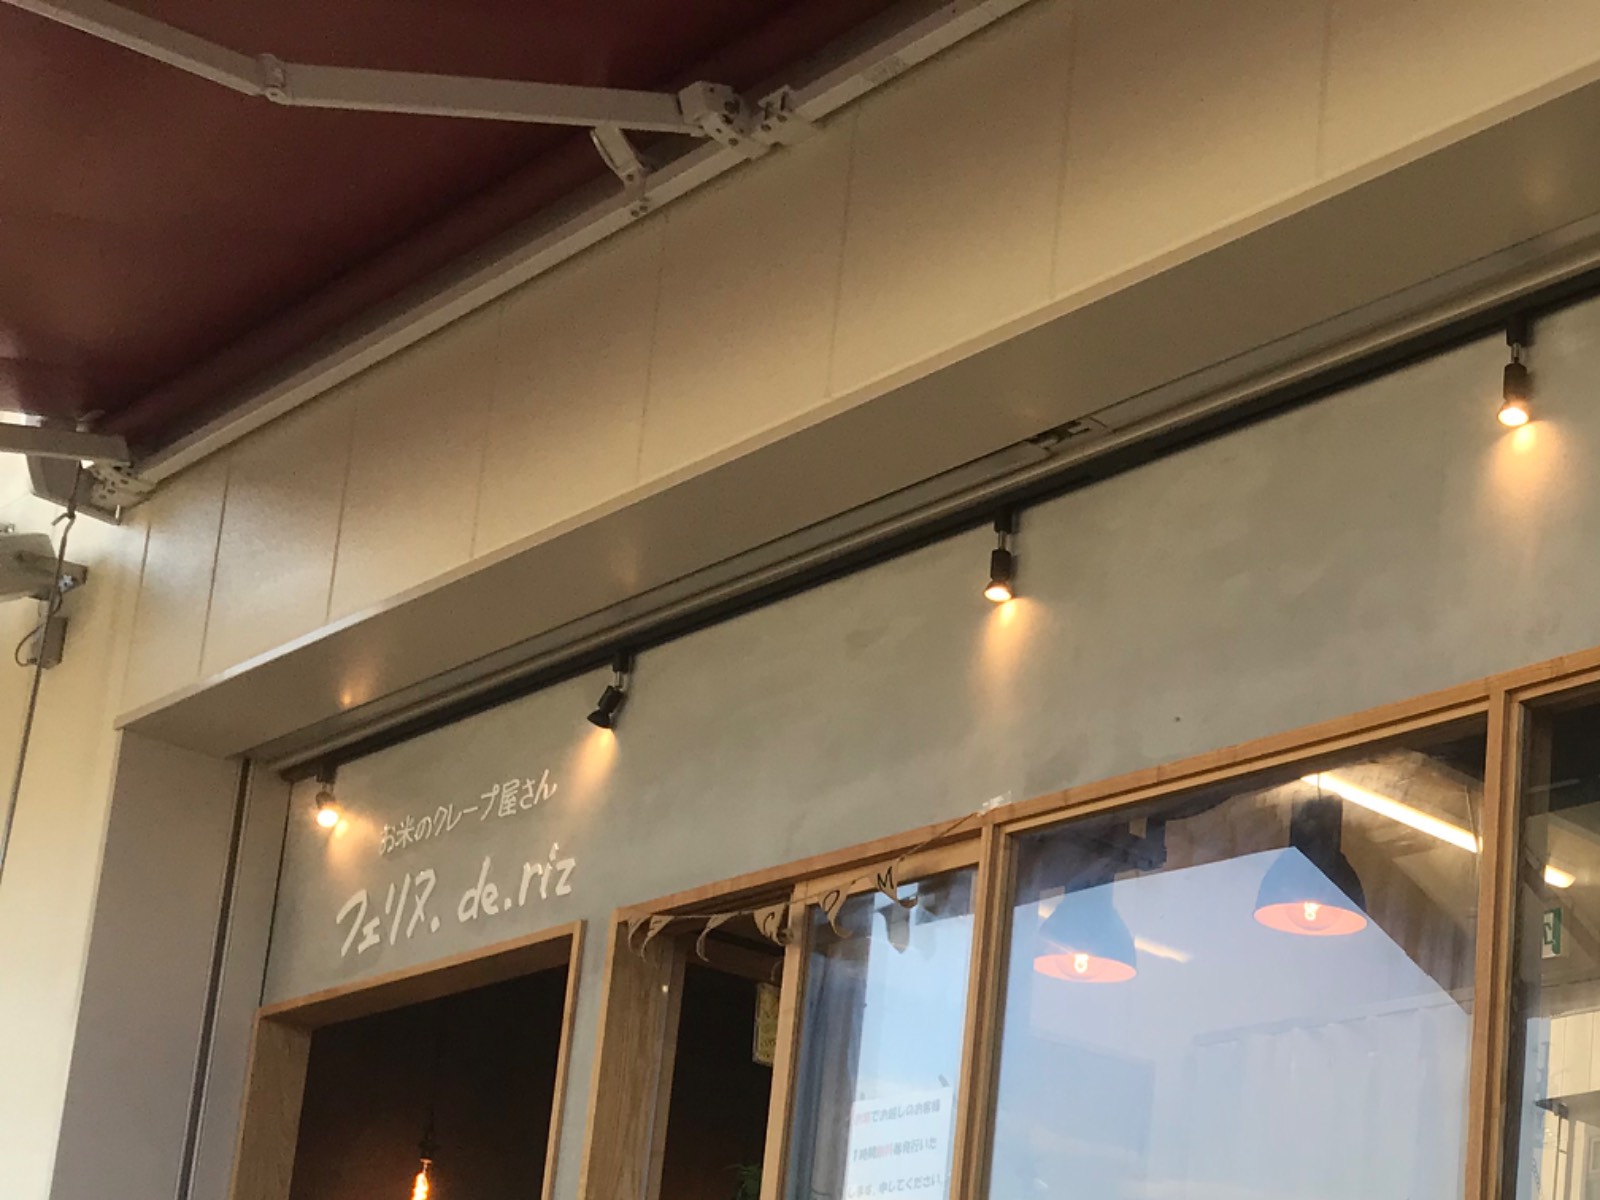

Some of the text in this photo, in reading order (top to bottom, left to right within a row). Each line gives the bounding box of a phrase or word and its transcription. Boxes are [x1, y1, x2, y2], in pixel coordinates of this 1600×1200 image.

[378, 768, 558, 857] お米のクレープ屋さん
